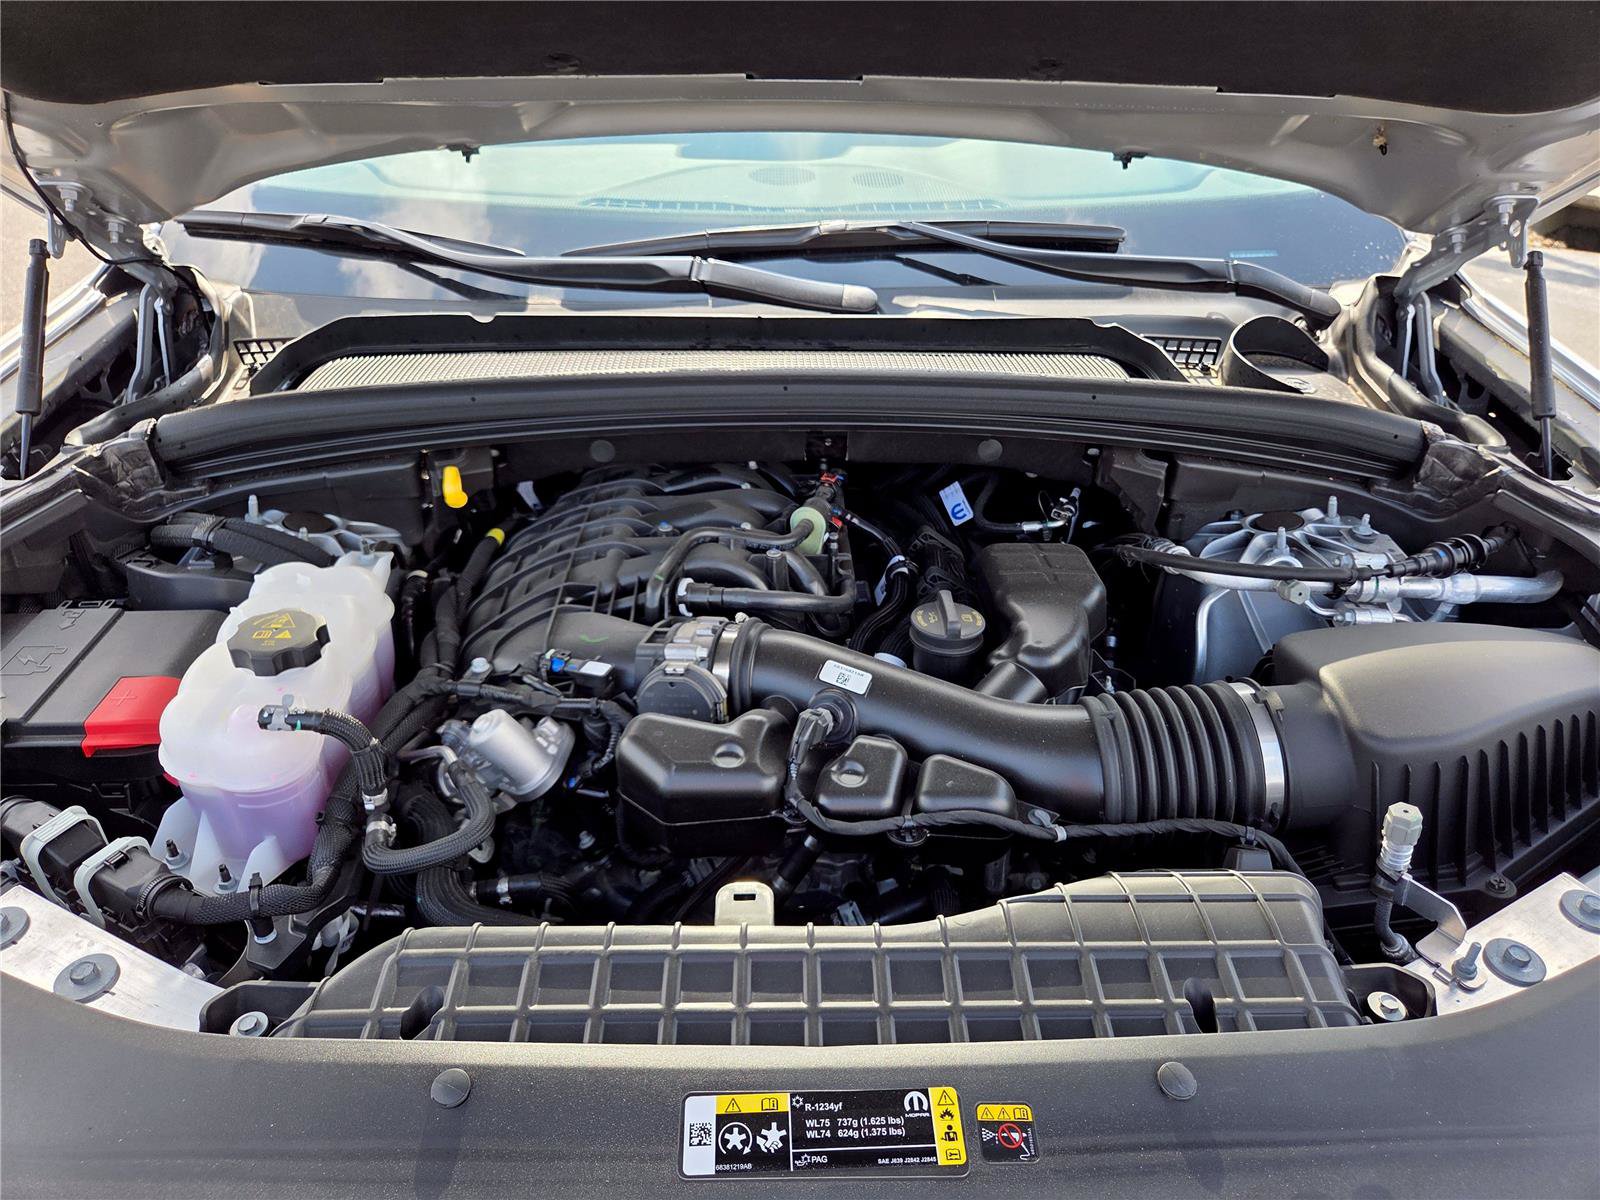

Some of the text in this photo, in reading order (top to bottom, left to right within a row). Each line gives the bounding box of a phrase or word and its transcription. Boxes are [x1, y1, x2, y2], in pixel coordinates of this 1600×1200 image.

[805, 1102, 842, 1112] R-1234yf
[805, 1116, 905, 1128] WL75 737g (1.625 lbs)
[806, 1127, 906, 1139] WL74 624g (1.375 lbs)
[811, 1155, 828, 1163] PAG
